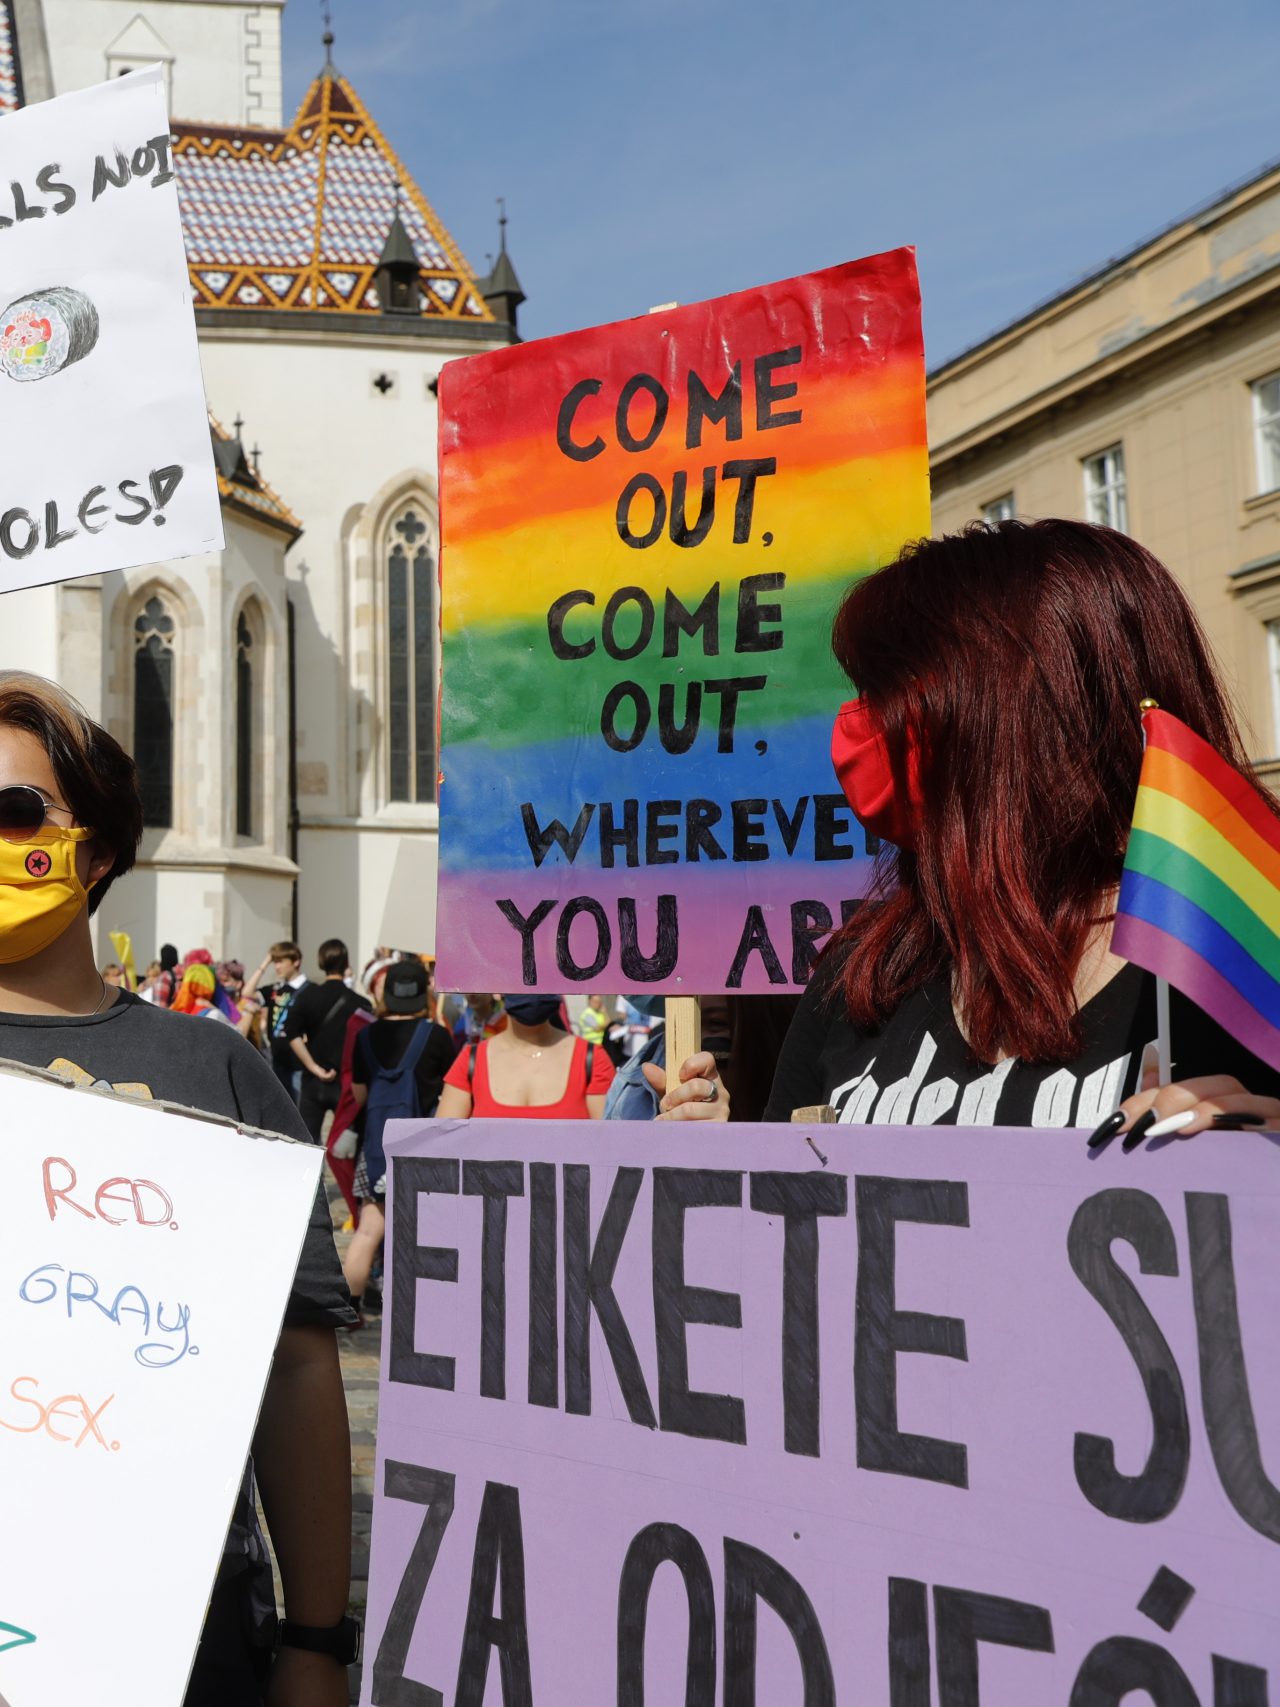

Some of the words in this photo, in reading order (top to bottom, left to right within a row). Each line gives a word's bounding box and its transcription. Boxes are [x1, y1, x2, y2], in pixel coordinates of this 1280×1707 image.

[556, 346, 803, 462] COME
[616, 457, 777, 549] OUT,
[546, 571, 786, 661] COME
[600, 675, 768, 757] OUT,
[519, 793, 881, 868] WHEREVE
[495, 894, 679, 987] YOU
[725, 899, 885, 989] AR
[41, 1157, 179, 1231] RED.
[389, 1156, 970, 1490] ETIKETE
[371, 1458, 535, 1707] ZA
